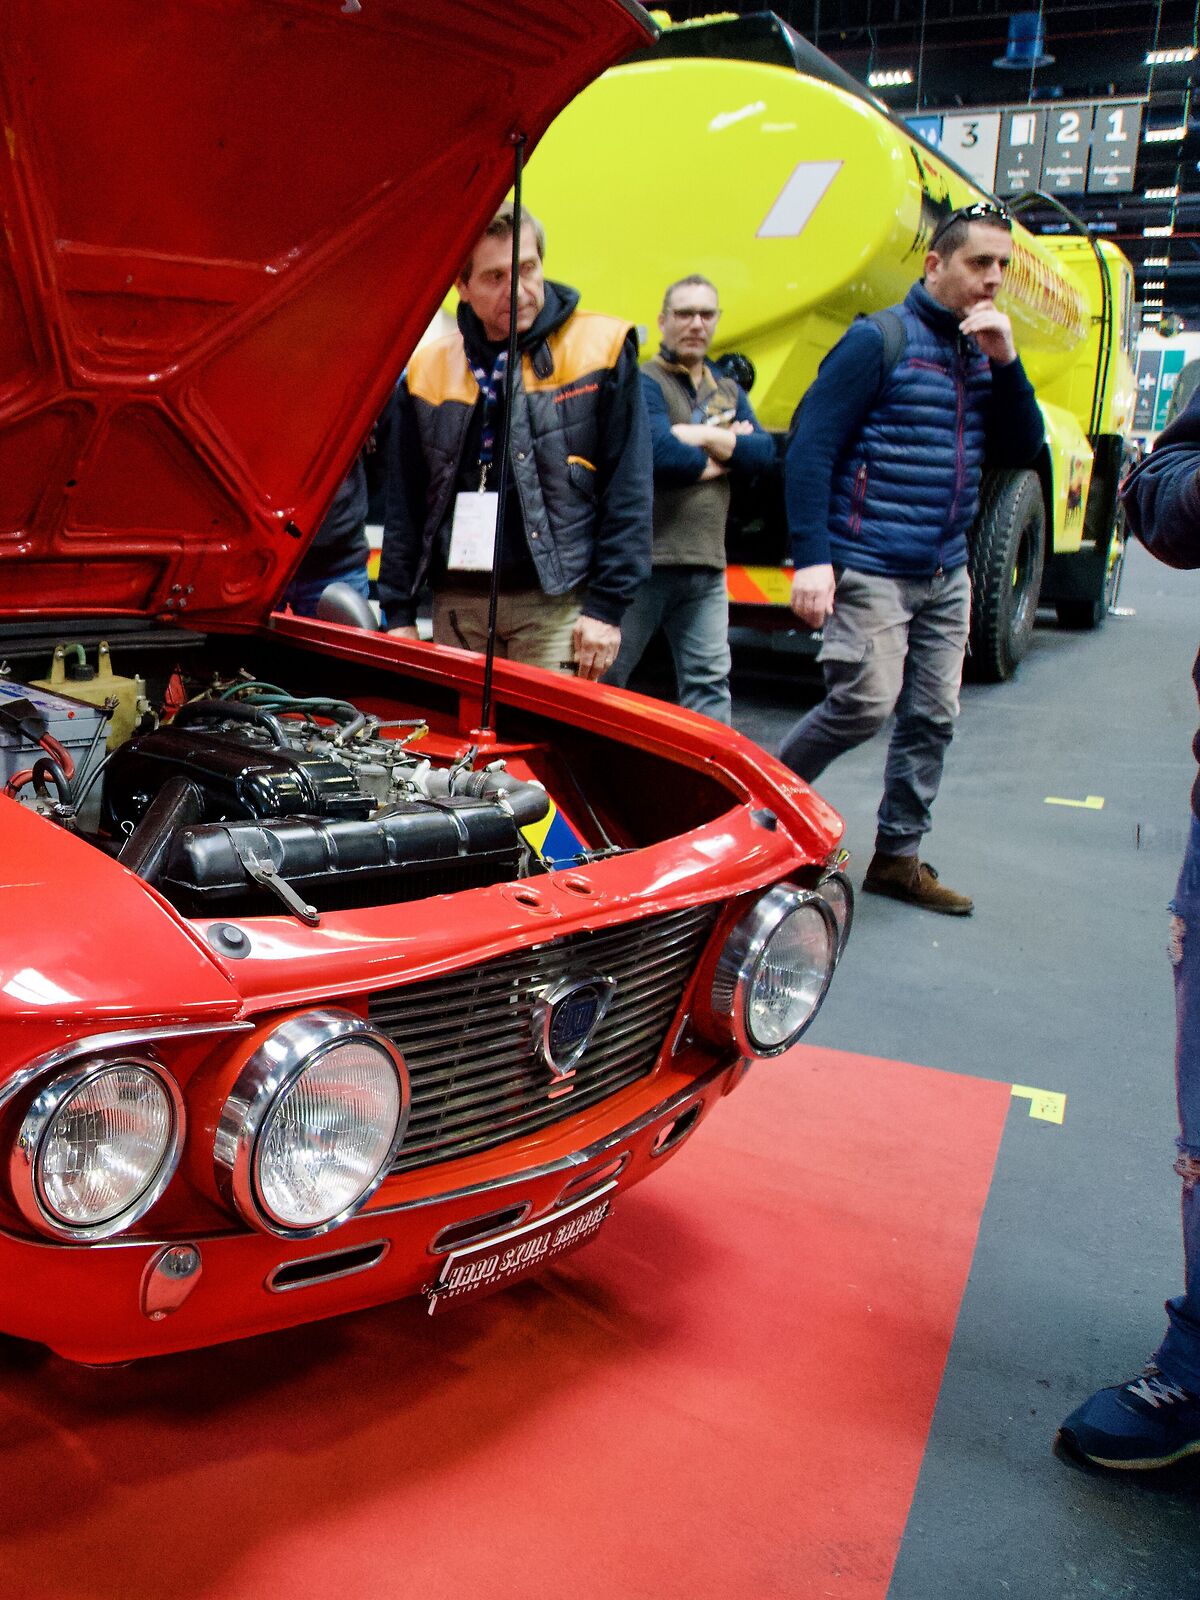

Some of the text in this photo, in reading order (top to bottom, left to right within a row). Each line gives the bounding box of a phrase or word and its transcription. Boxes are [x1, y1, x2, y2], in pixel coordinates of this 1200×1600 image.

[961, 122, 980, 148] 3
[1056, 111, 1081, 144] 2
[1104, 108, 1128, 143] 1
[448, 1200, 610, 1290] HARD SKULL GARAGE
